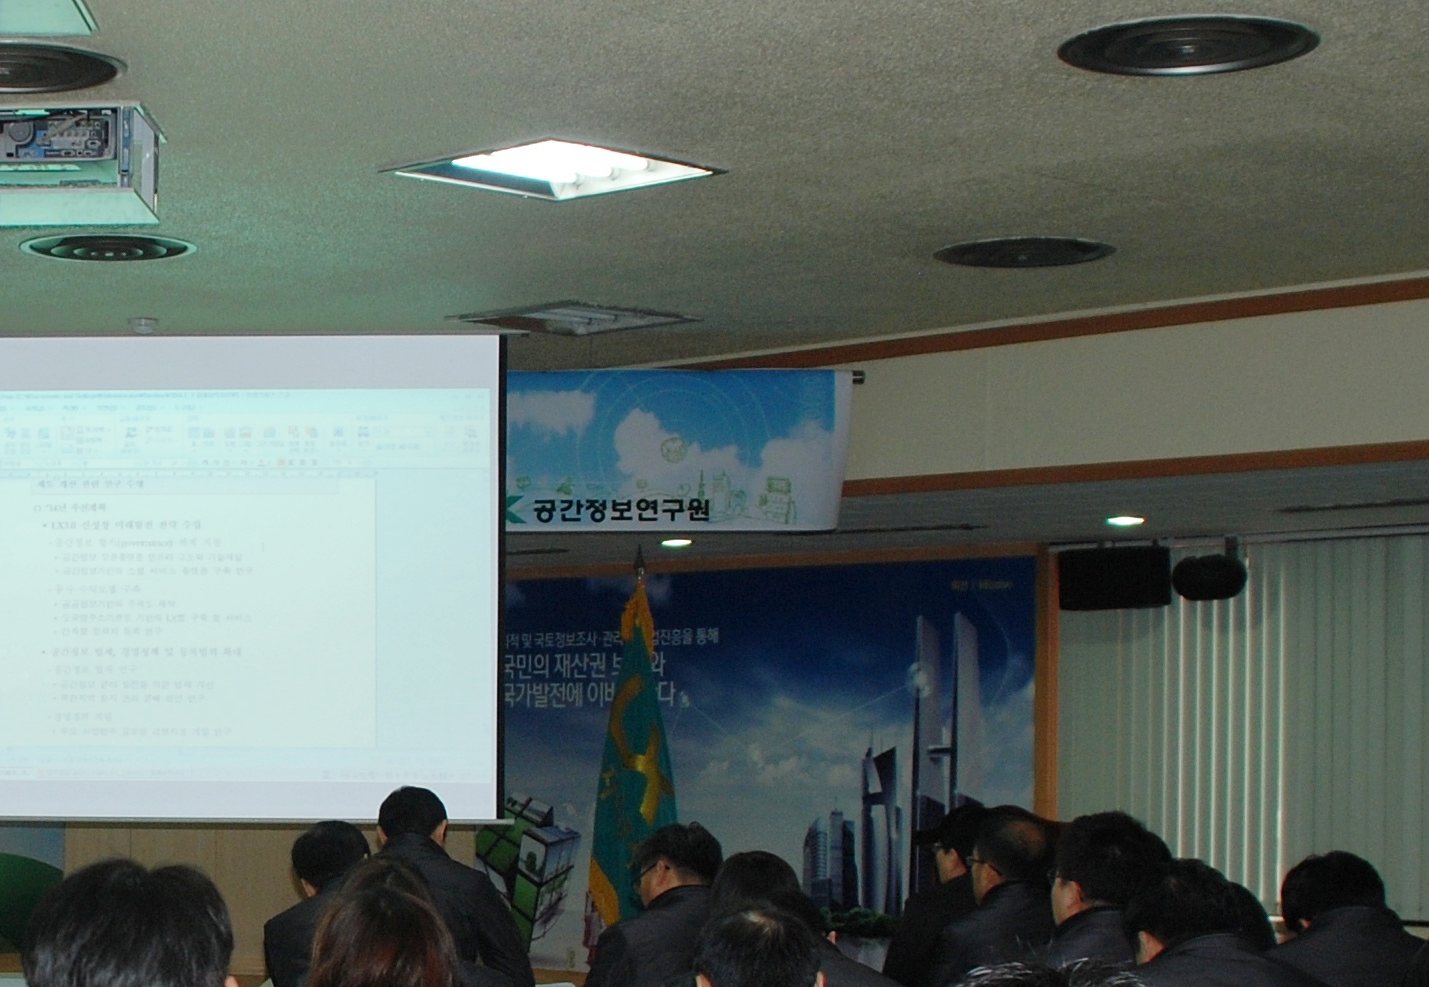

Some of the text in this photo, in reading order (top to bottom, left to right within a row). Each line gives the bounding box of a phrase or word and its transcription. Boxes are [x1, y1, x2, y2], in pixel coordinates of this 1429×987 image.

[533, 498, 710, 524] 공간정보연구원
[696, 627, 720, 645] 통해
[504, 653, 549, 680] 국민의
[553, 652, 606, 679] 재산권
[504, 681, 584, 709] 국가발전에
